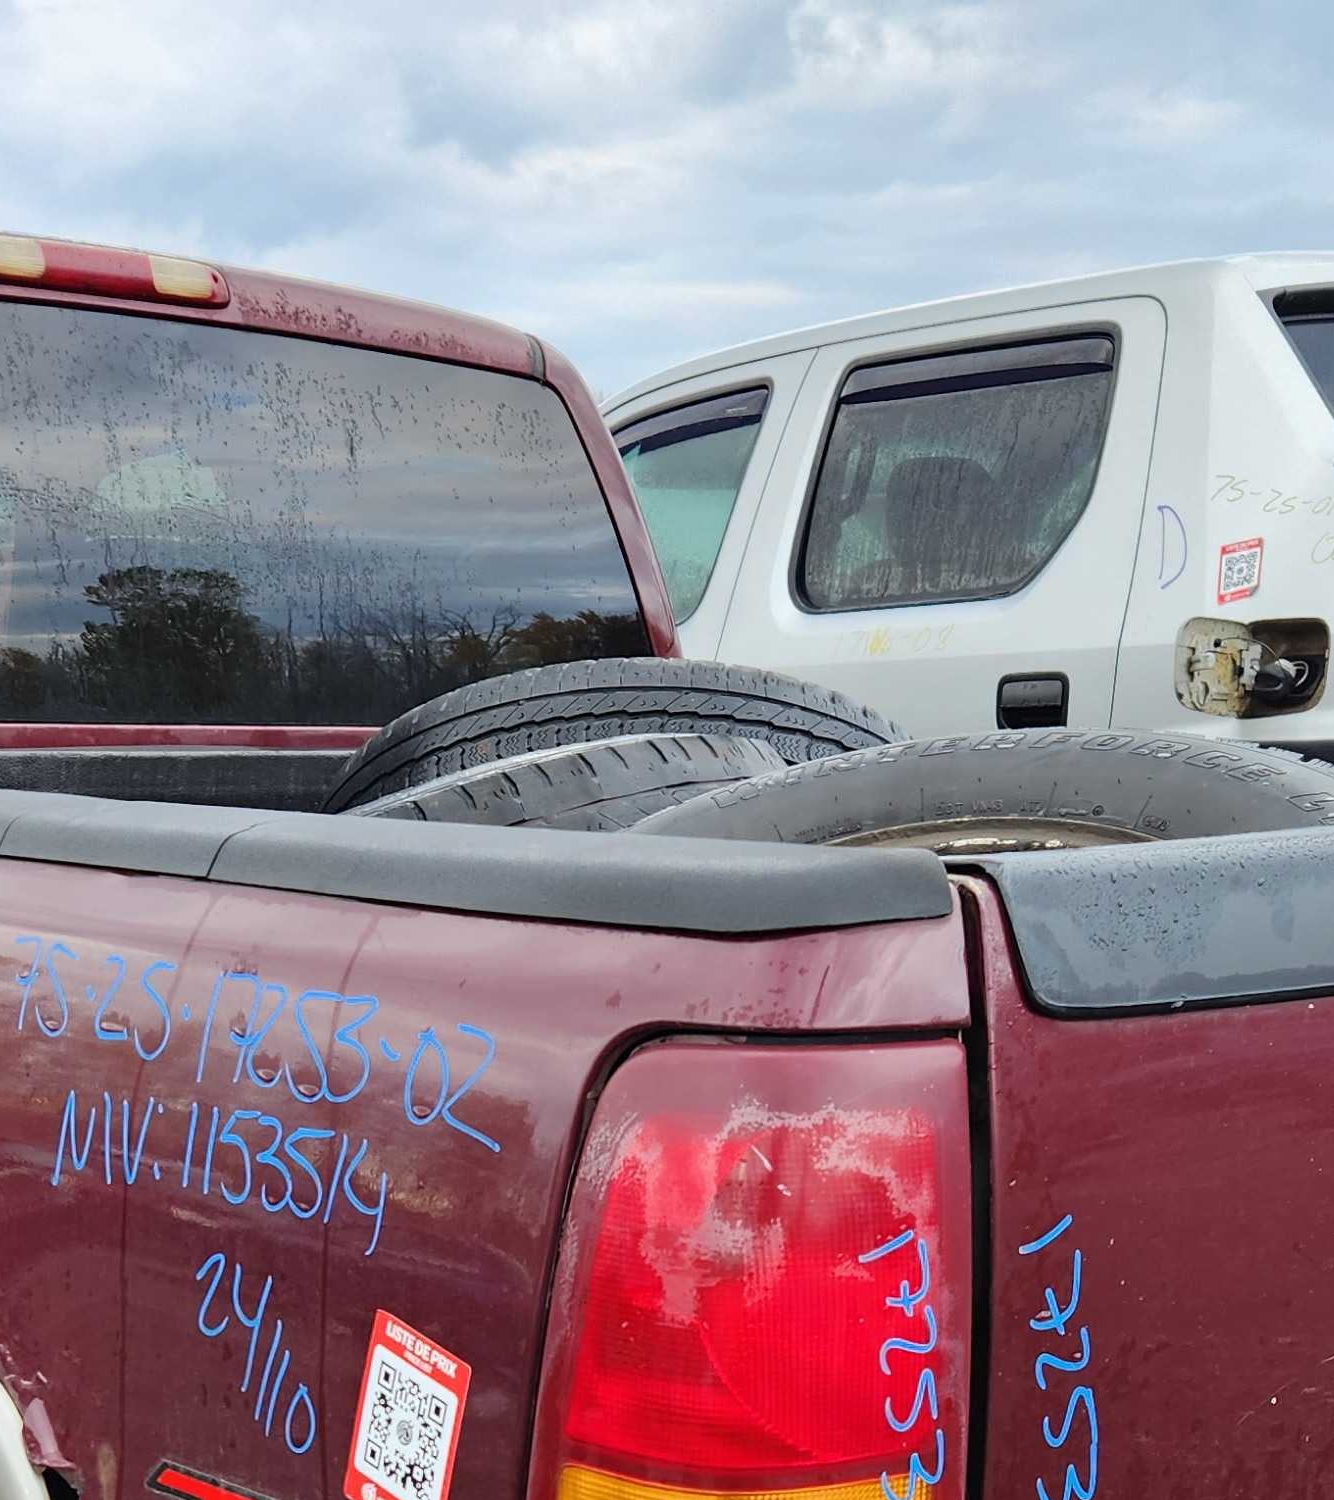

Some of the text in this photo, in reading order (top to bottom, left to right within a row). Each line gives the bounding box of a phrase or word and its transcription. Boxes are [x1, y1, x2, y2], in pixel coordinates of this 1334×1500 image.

[711, 731, 1287, 809] WINTERFORCE
[385, 1320, 416, 1351] LISTE
[414, 1339, 432, 1362] DE
[430, 1350, 458, 1379] PRIX
